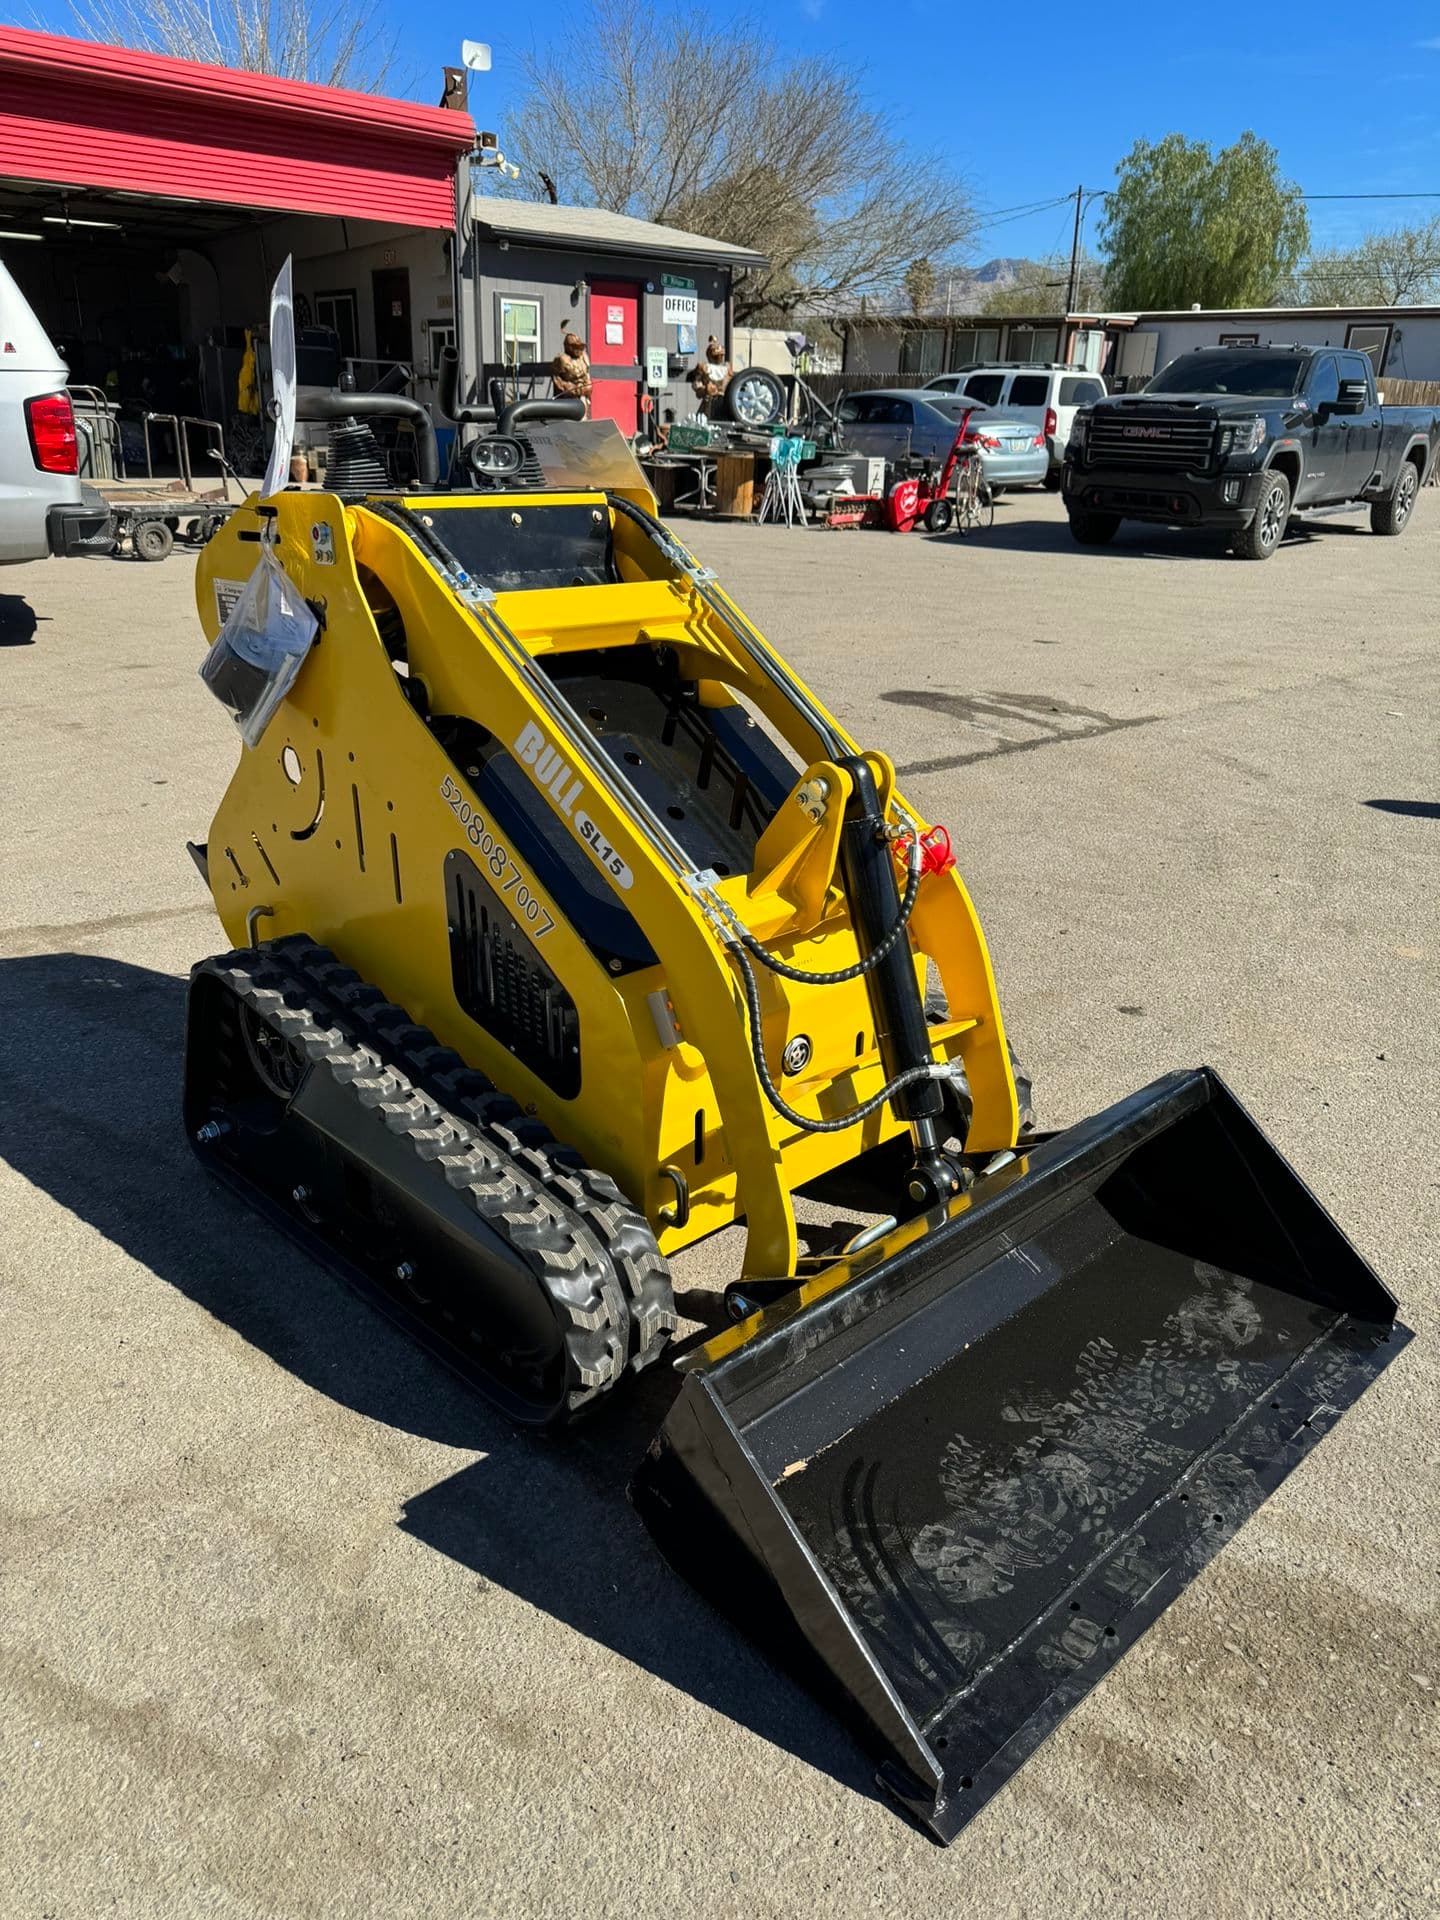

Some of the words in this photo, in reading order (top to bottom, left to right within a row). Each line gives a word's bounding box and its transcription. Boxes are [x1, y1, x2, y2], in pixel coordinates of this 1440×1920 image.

[665, 297, 696, 312] OFFICE
[1122, 425, 1170, 438] GMC
[513, 719, 585, 818] BULL
[439, 773, 557, 939] 5208087007
[579, 820, 625, 876] SL15
